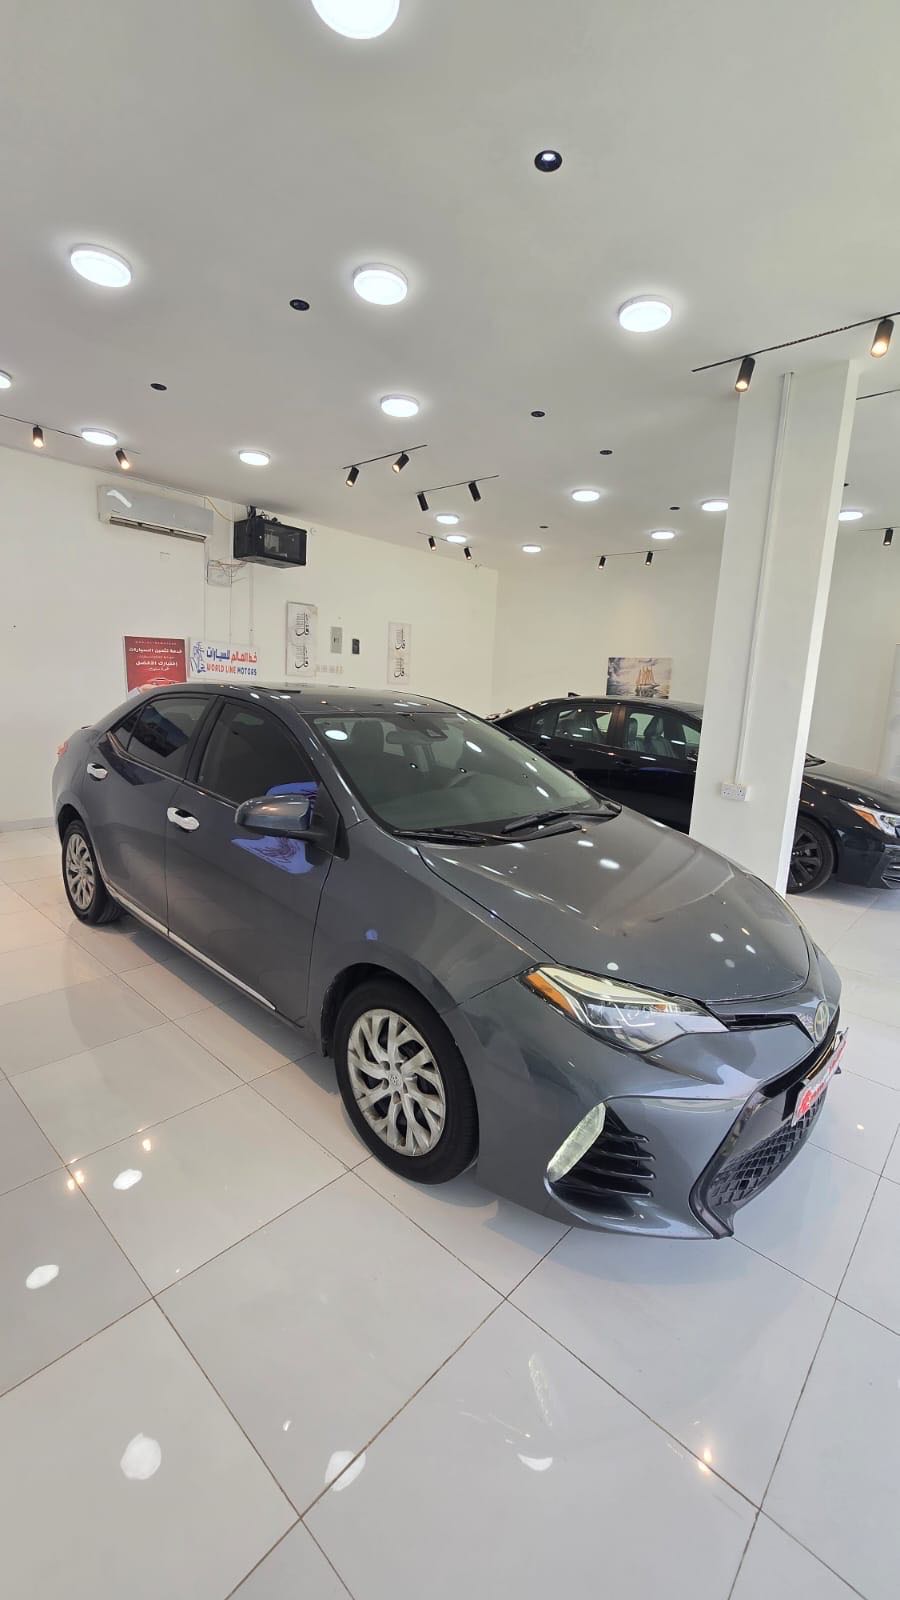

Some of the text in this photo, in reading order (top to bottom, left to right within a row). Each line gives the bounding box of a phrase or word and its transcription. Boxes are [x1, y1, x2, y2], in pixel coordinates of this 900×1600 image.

[206, 663, 257, 676] WORLD LINE MOTORS
